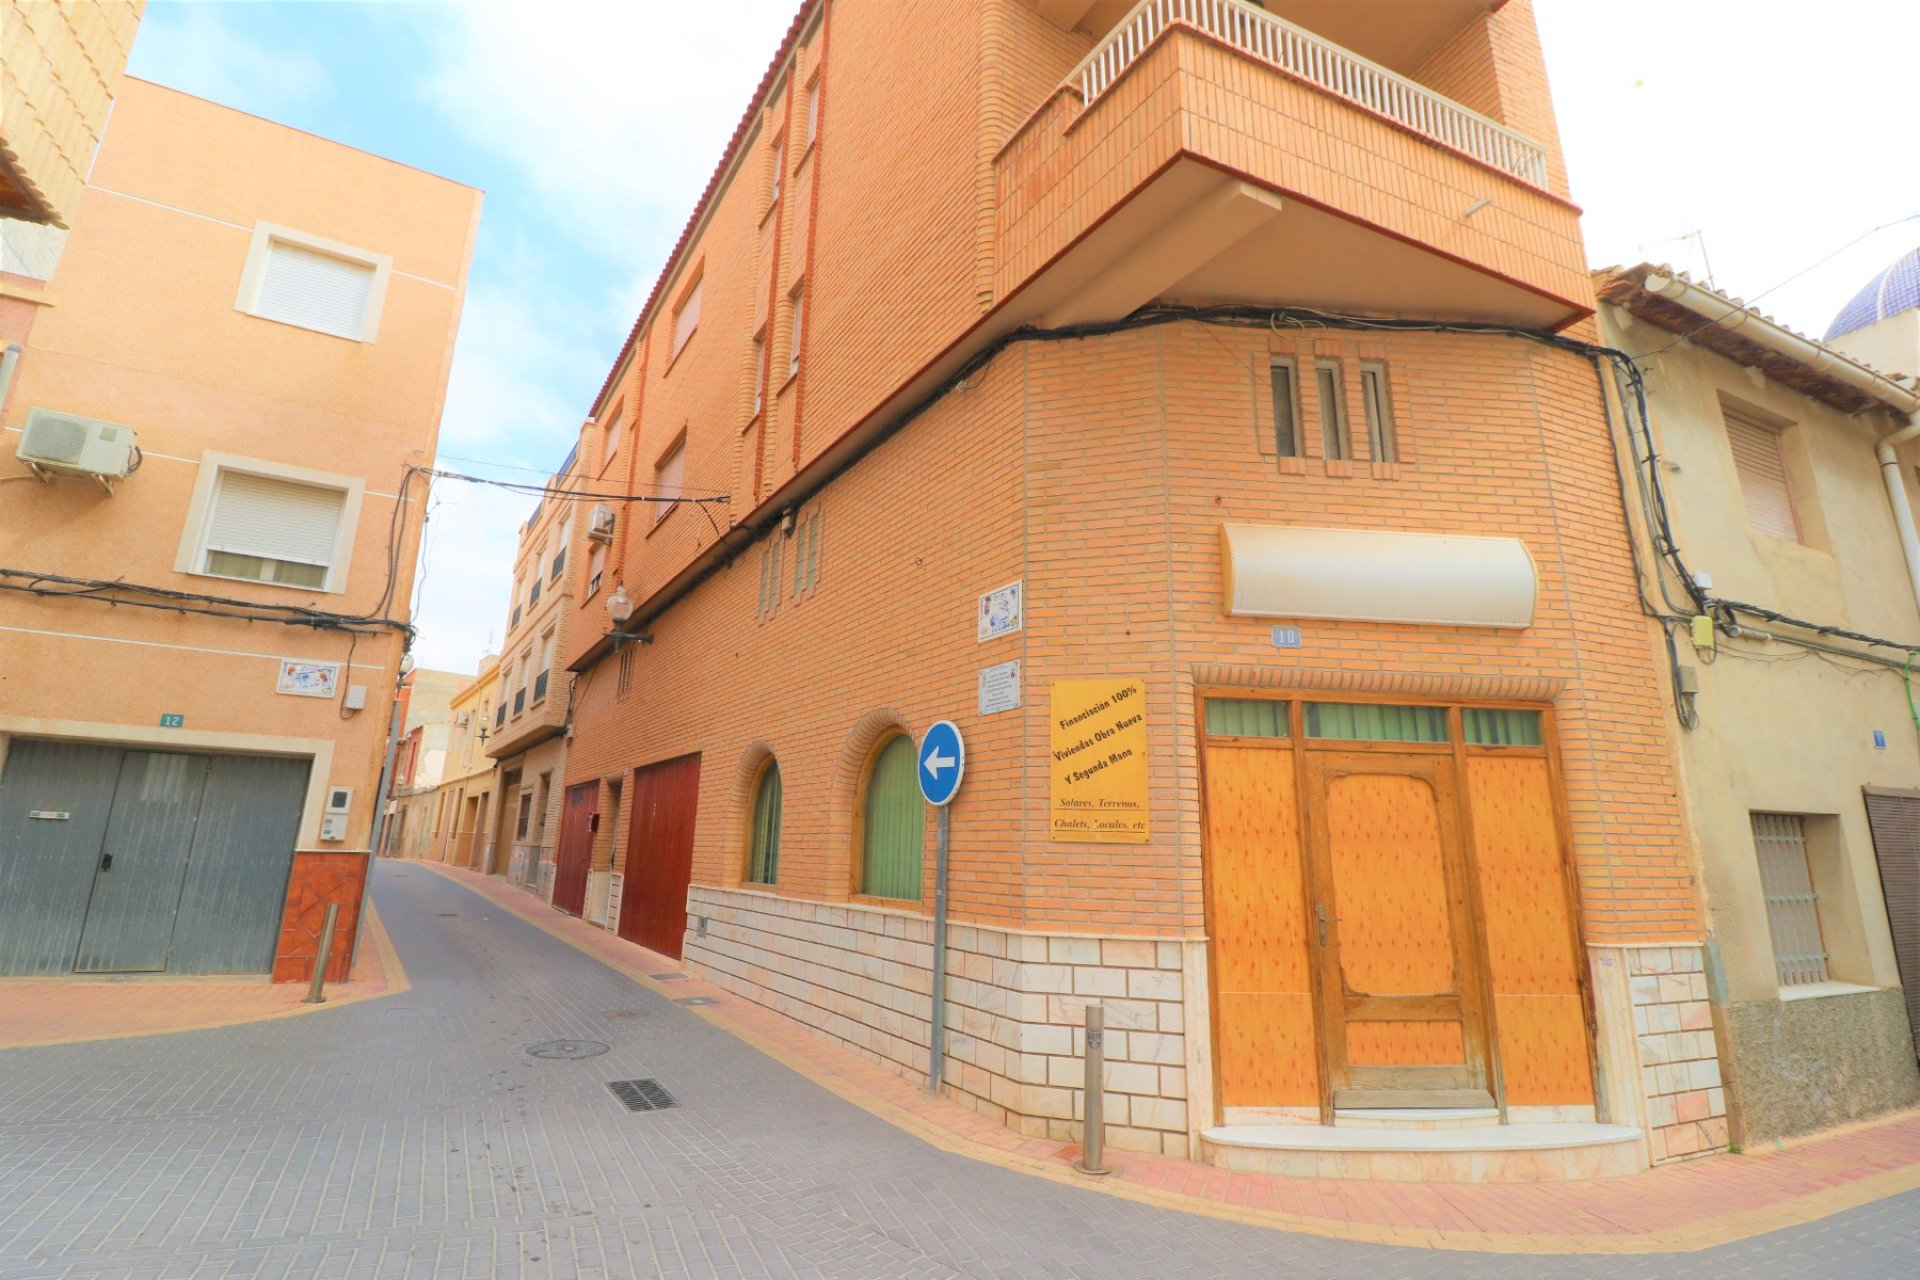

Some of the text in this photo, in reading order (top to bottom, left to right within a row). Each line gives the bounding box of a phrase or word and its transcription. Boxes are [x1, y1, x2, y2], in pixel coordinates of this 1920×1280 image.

[1280, 630, 1294, 644] 10
[1060, 685, 1137, 730] Financiación 100%
[166, 716, 178, 726] 12
[1054, 714, 1142, 761] Viviendas Obra Nueva
[1064, 749, 1133, 784] Y Segunda Mano
[1060, 798, 1095, 808] Solares,
